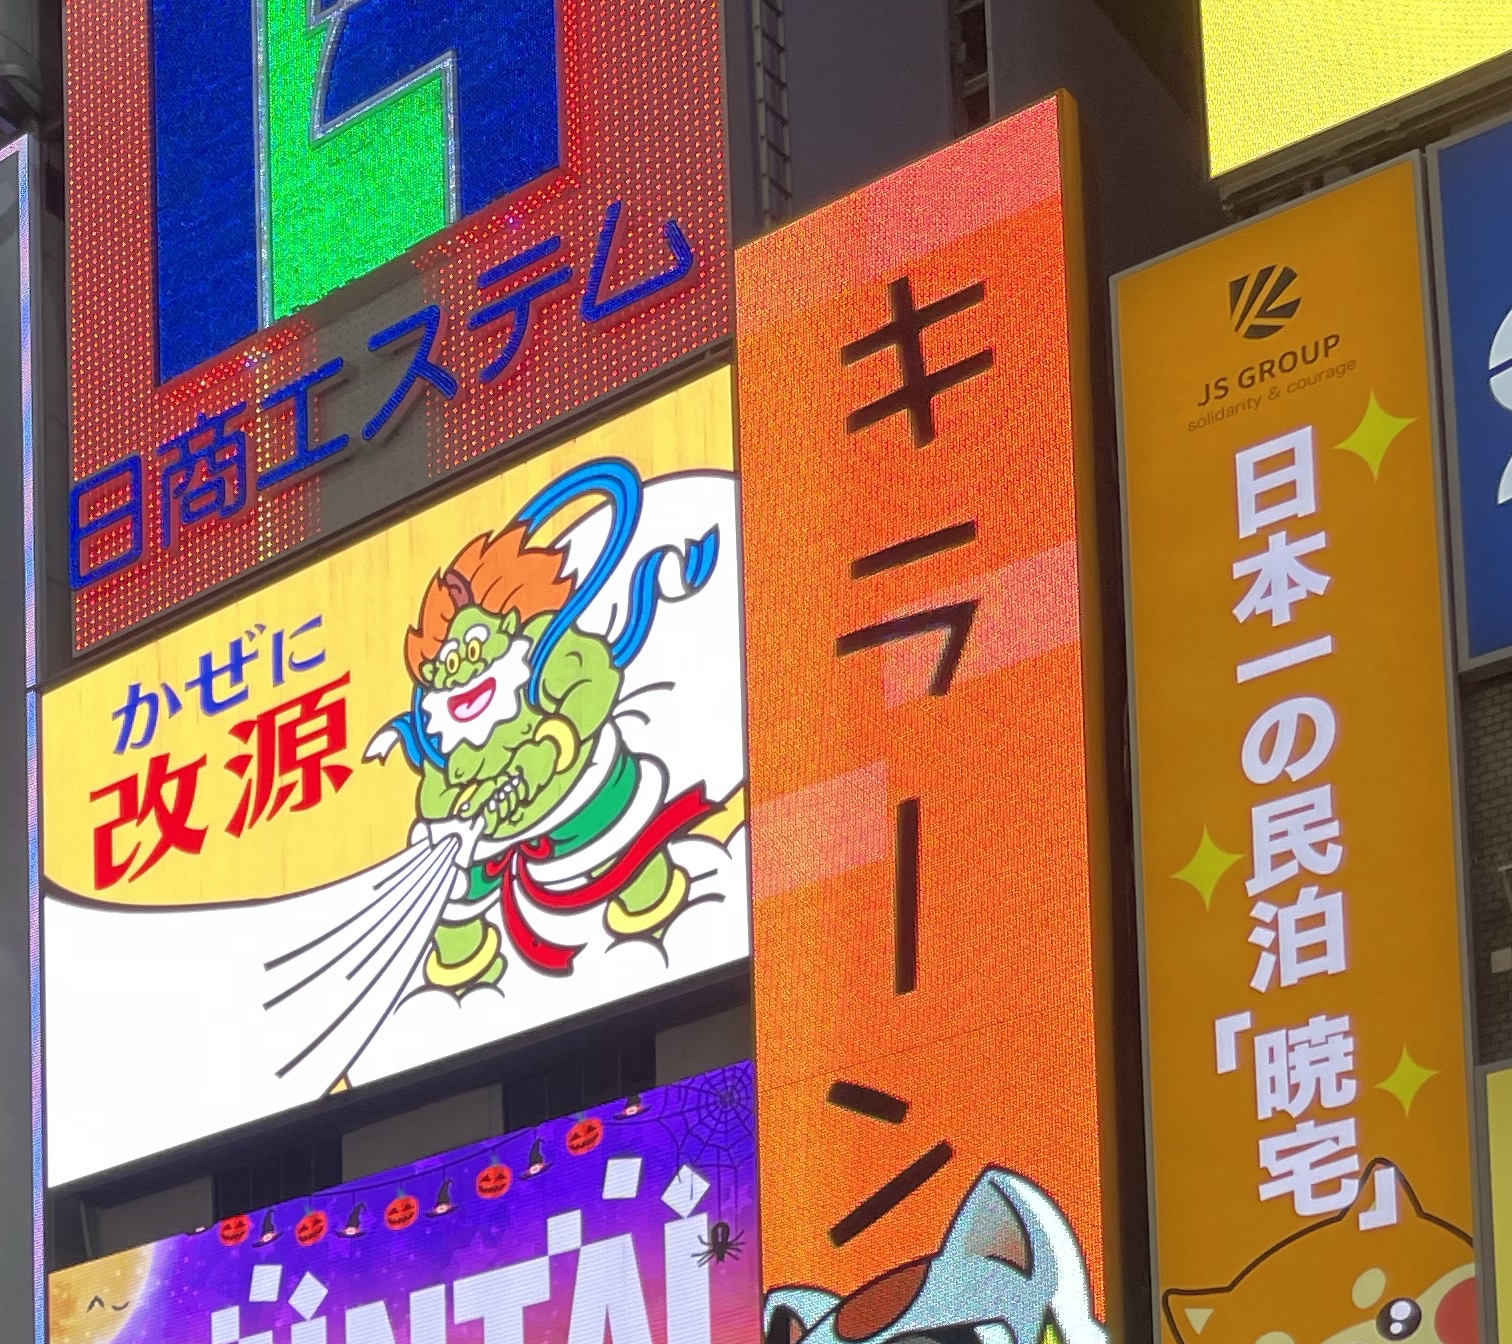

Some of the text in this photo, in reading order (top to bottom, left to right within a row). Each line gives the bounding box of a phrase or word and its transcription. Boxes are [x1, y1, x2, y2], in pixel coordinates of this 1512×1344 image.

[68, 201, 693, 592] 日商エステム
[1187, 359, 1357, 433] solidarity & courage
[1196, 333, 1340, 408] JS GROUP
[112, 614, 327, 756] かぜに
[828, 276, 994, 1248] キラーン
[89, 671, 354, 890] 改源
